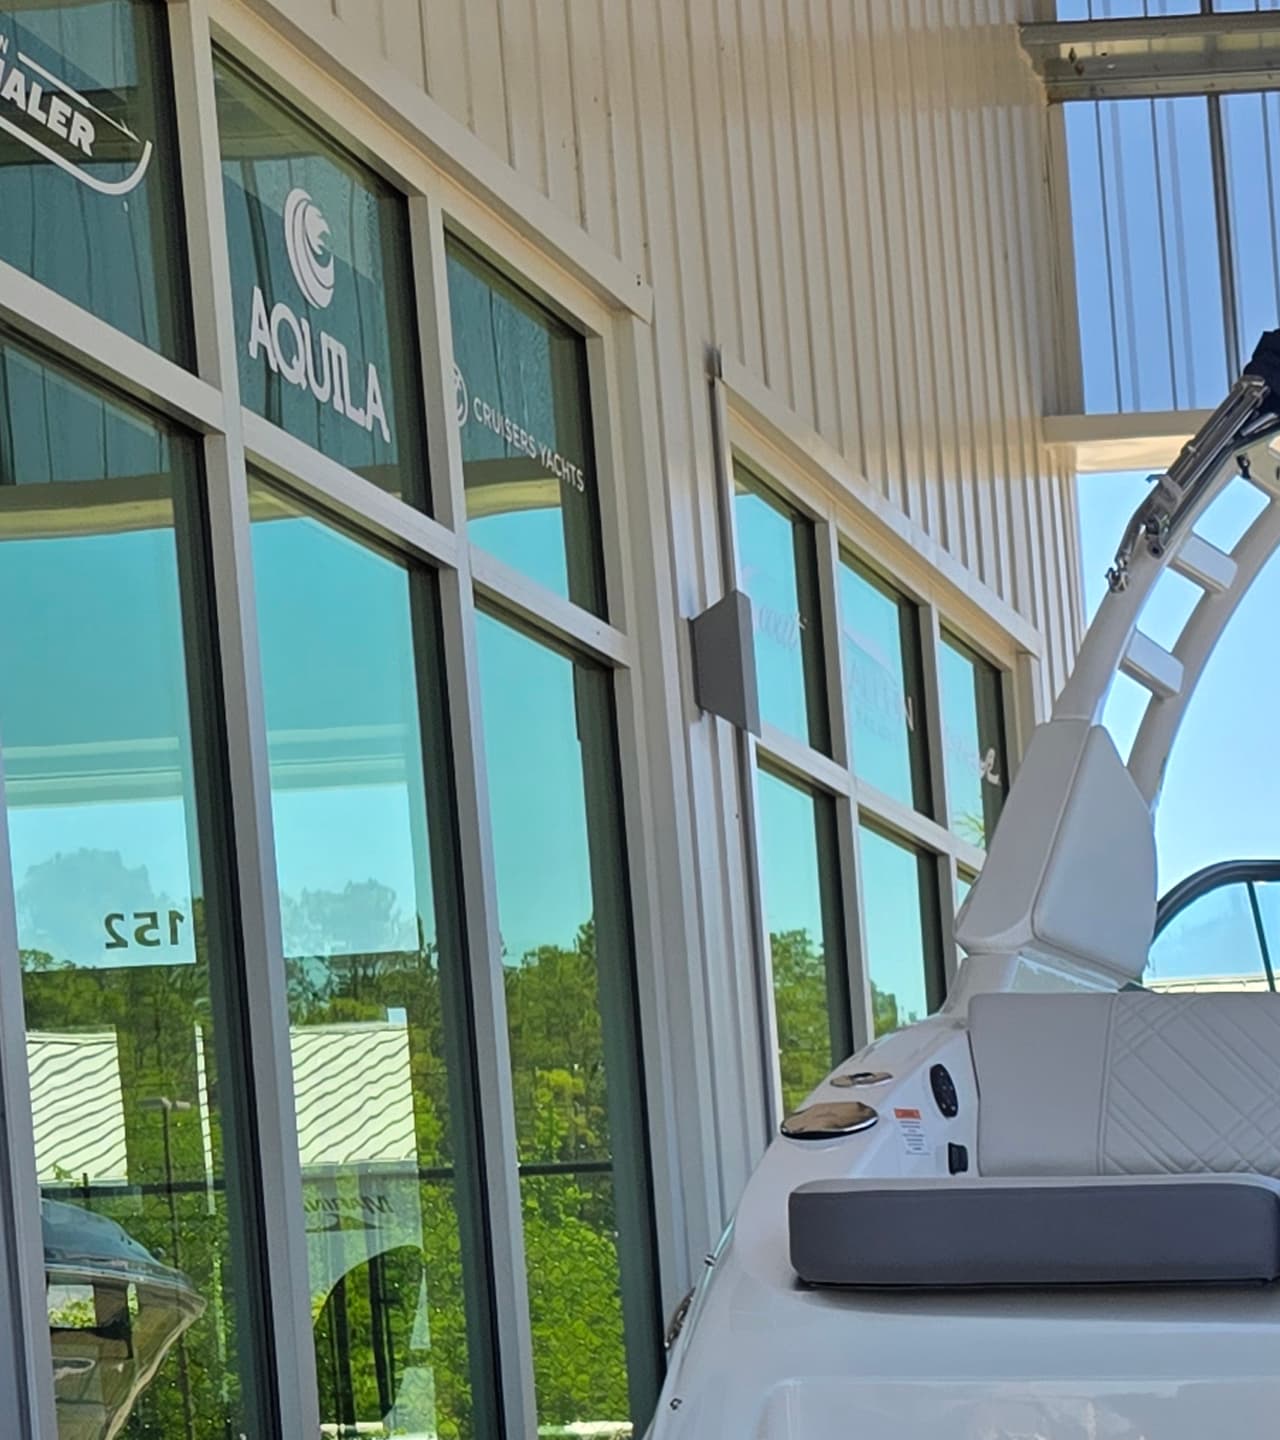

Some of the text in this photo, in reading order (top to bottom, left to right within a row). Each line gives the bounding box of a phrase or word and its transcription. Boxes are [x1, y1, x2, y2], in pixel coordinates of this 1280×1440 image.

[248, 285, 391, 444] AQUILA
[473, 397, 585, 493] CRUISERS YACHTS
